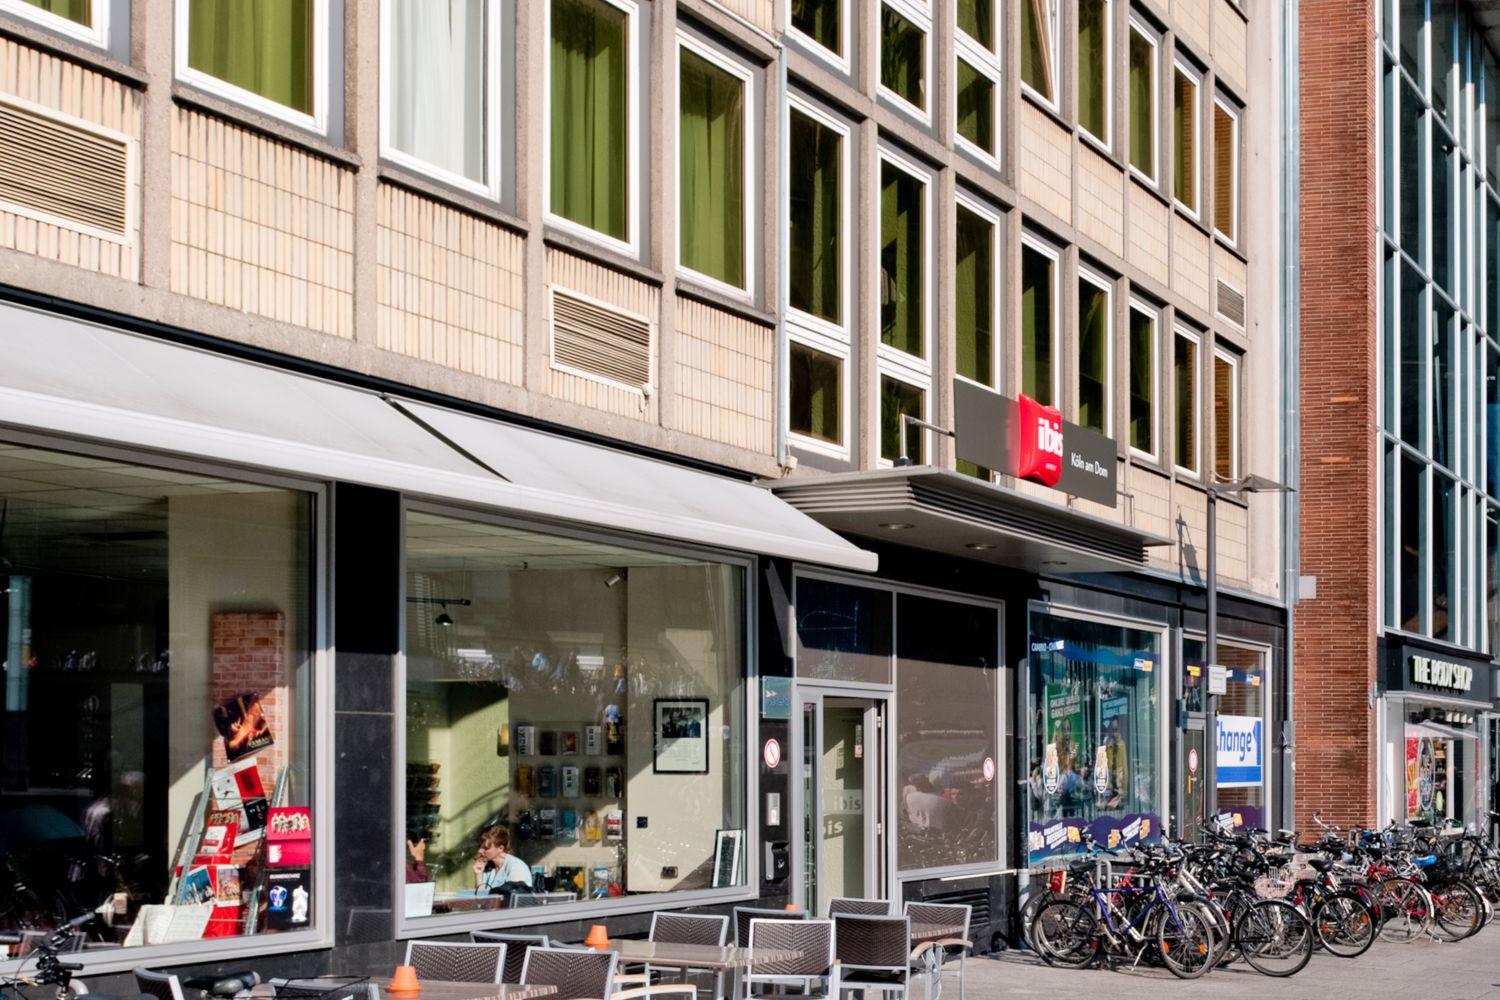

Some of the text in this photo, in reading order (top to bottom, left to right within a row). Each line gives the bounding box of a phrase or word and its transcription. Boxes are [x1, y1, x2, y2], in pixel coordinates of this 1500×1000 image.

[1038, 417, 1063, 457] ibis
[1071, 452, 1084, 470] Köln
[1085, 461, 1094, 473] am
[1095, 461, 1108, 478] Dom
[1412, 655, 1431, 684] THE
[1431, 659, 1453, 687] BODY
[1453, 664, 1473, 691] SHOP
